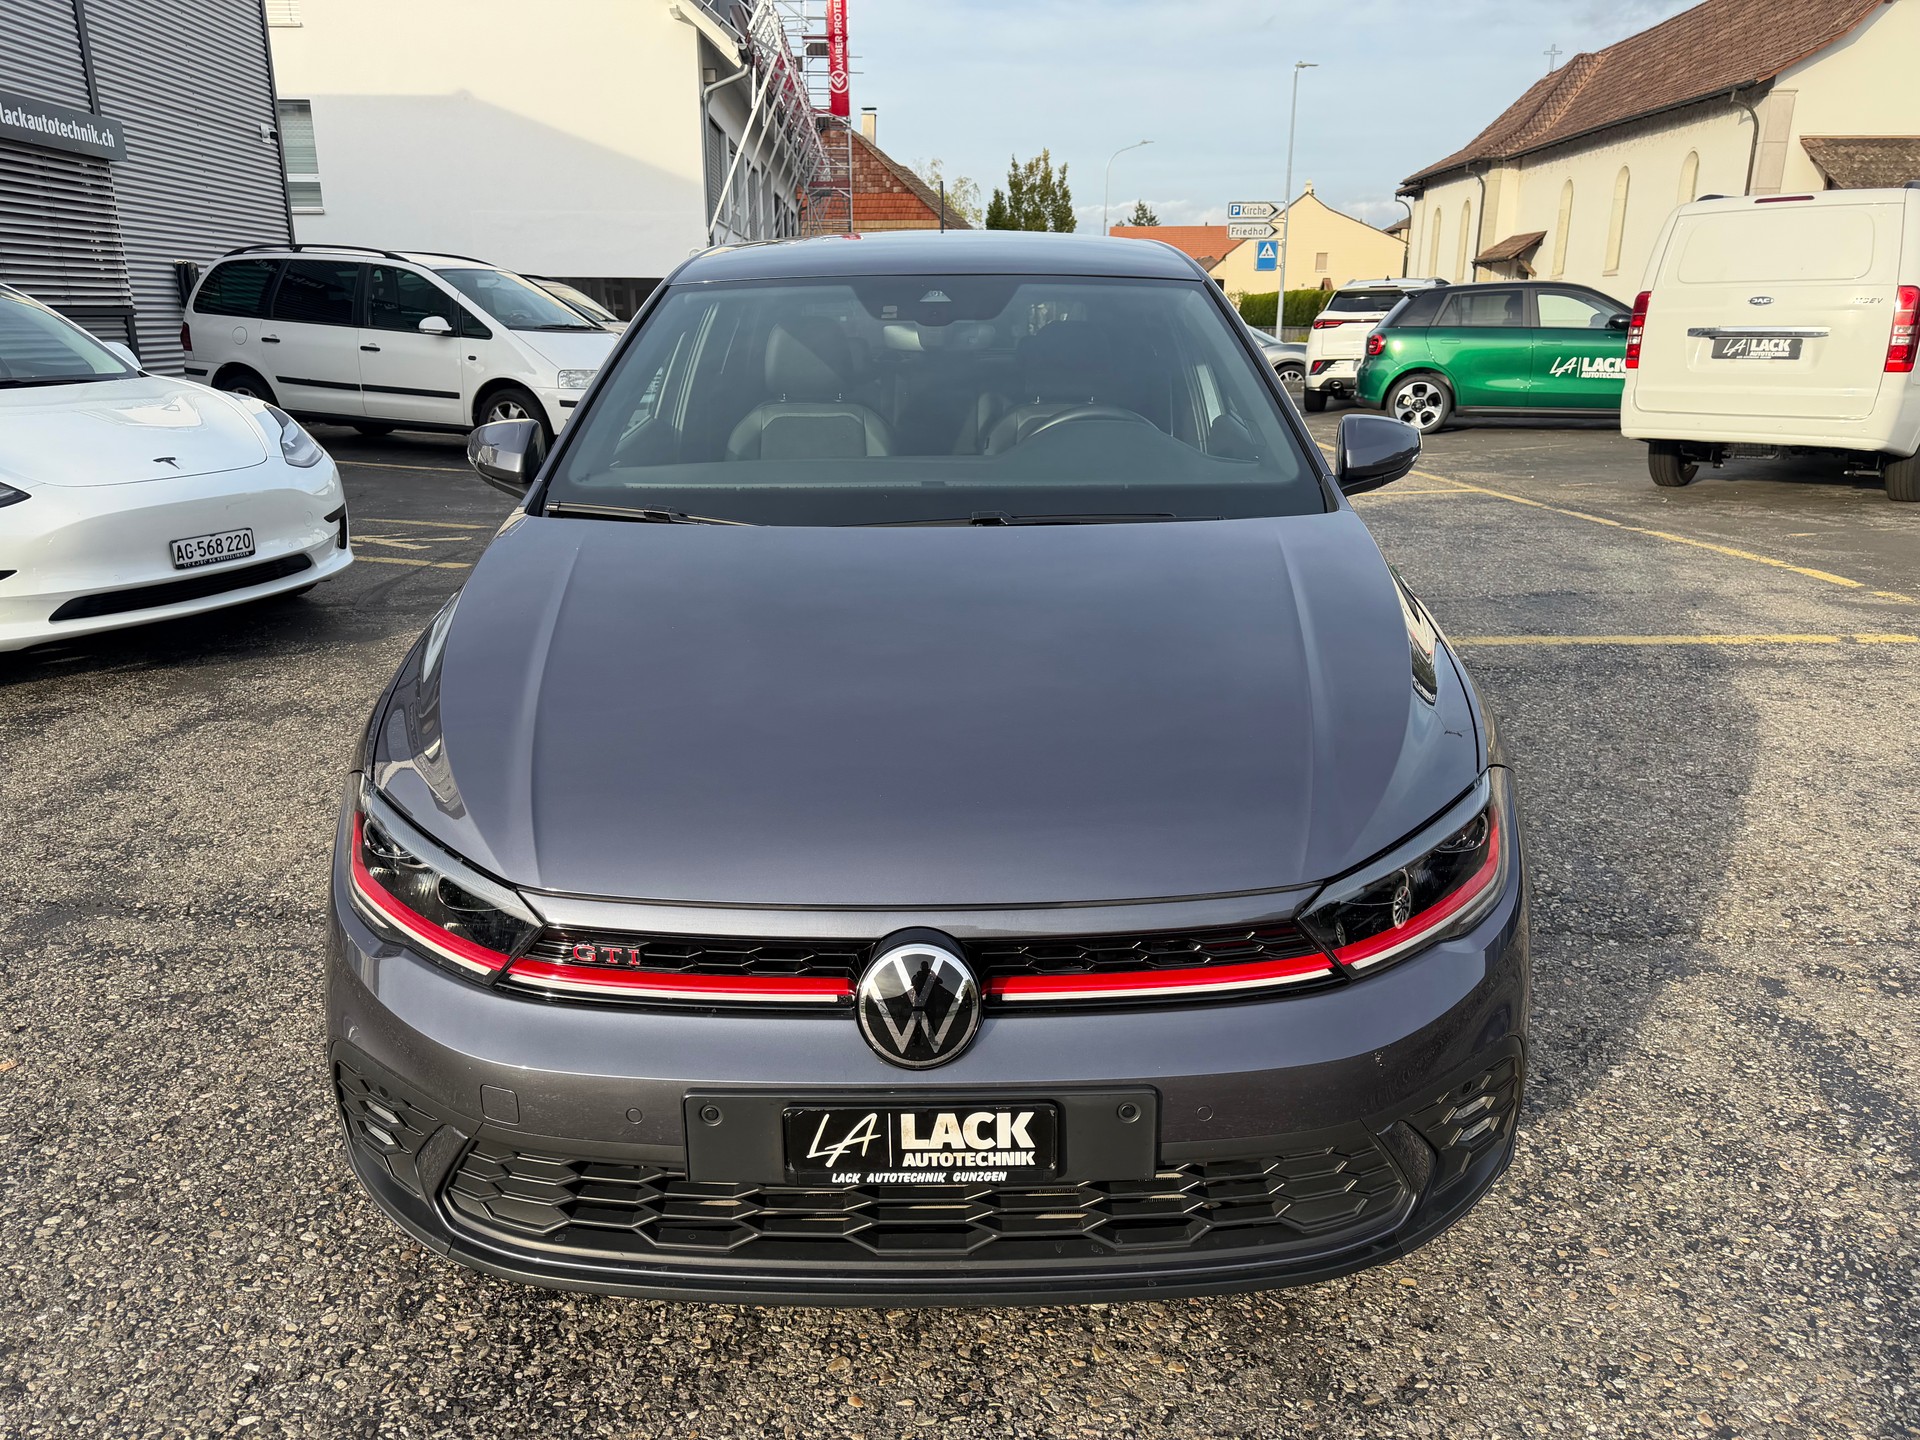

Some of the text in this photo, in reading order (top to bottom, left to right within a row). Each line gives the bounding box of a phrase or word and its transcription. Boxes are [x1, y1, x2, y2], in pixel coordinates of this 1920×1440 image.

[834, 36, 844, 71] AMBER
[0, 102, 115, 148] lackautotechnik.ch
[1241, 205, 1267, 215] Kirche
[1231, 227, 1267, 236] Friedhof
[1750, 339, 1792, 351] LACK
[225, 533, 251, 552] 220
[573, 944, 640, 965] GTI
[900, 1111, 1036, 1150] LACK
[902, 1151, 1036, 1168] AUTOTECHNIK
[831, 1171, 1008, 1184] LACK AUTOTECHNIK GUNZGEN
